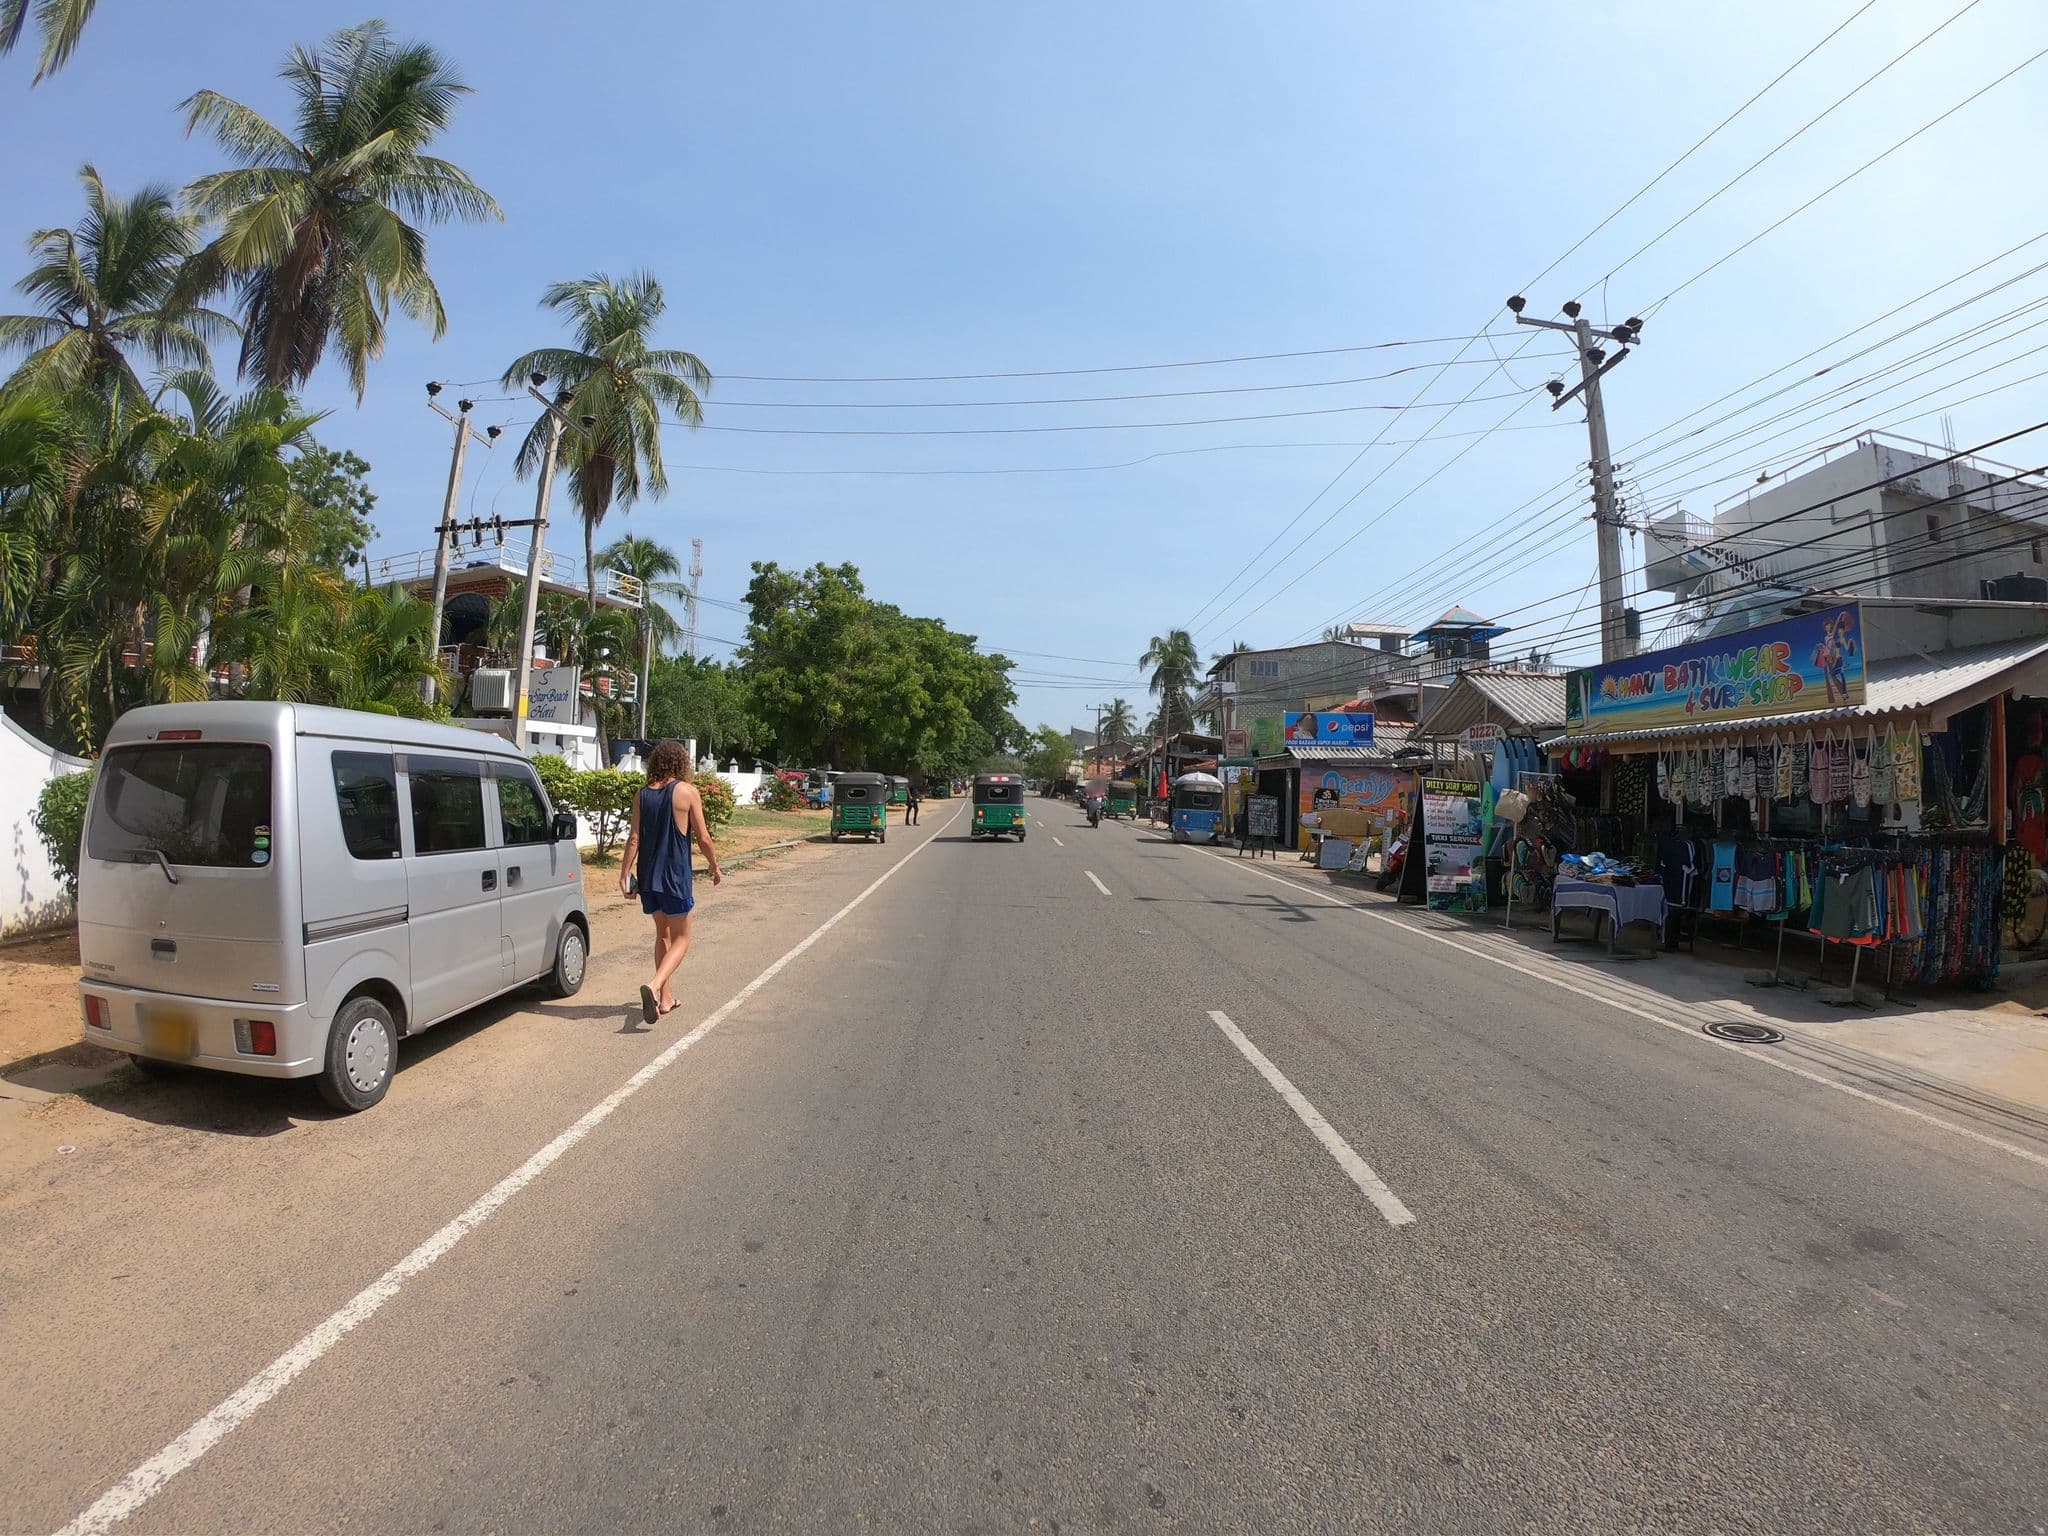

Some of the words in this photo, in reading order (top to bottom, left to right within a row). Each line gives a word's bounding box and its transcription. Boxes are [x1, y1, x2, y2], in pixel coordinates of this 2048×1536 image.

[1618, 671, 1656, 697] MANU
[1663, 656, 1721, 693] BATIK
[1722, 641, 1792, 682] WEAR
[1699, 683, 1746, 711] SURF
[1748, 674, 1805, 706] SHOP
[530, 703, 556, 718] Hotel
[1341, 723, 1369, 733] pepsi
[1470, 726, 1497, 738] DIZZY
[1426, 780, 1444, 790] DIZZY
[1445, 782, 1461, 791] SURF
[1462, 783, 1478, 792] SHOP
[1449, 836, 1477, 844] SERVICE
